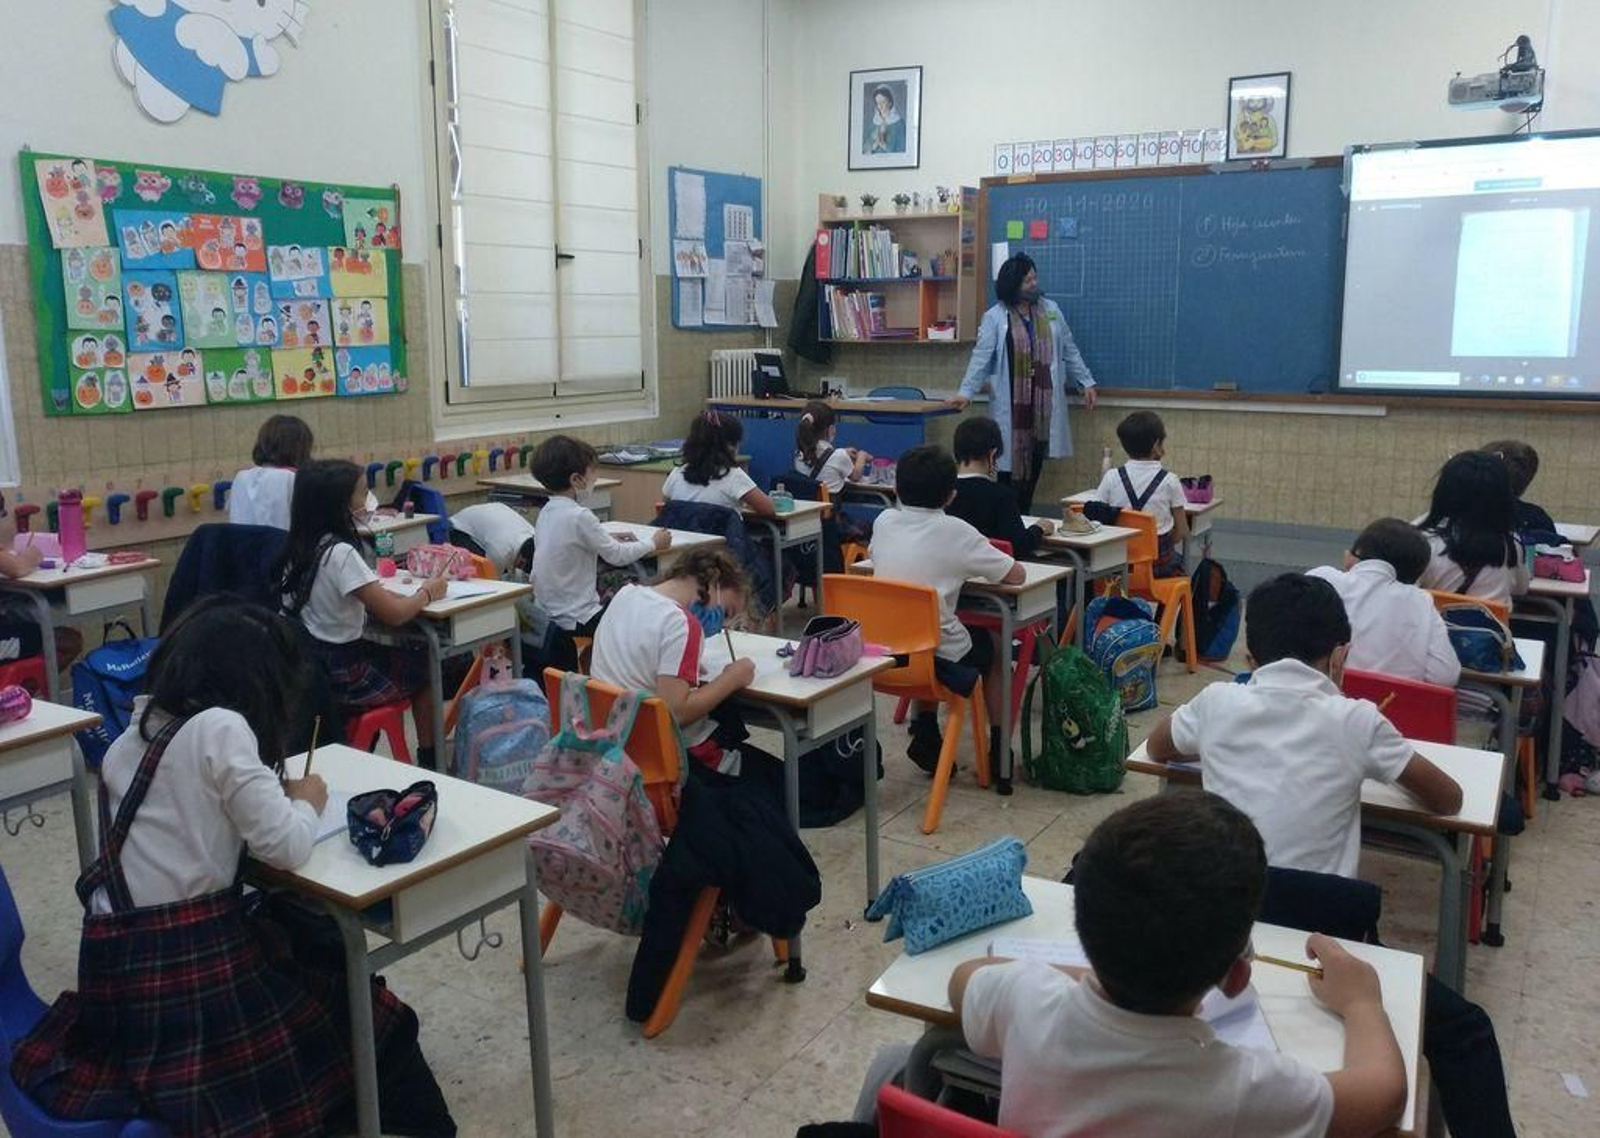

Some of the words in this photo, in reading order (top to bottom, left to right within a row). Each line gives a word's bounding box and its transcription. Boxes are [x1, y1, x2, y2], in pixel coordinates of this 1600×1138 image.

[998, 154, 1008, 169] 0
[1014, 152, 1030, 167] 10
[1034, 149, 1052, 163] 20
[1053, 147, 1072, 162] 30
[1074, 145, 1093, 160] 40
[1095, 143, 1114, 158] 50
[1116, 142, 1136, 158] 60
[1159, 140, 1179, 155] 80
[1182, 138, 1201, 153] 90
